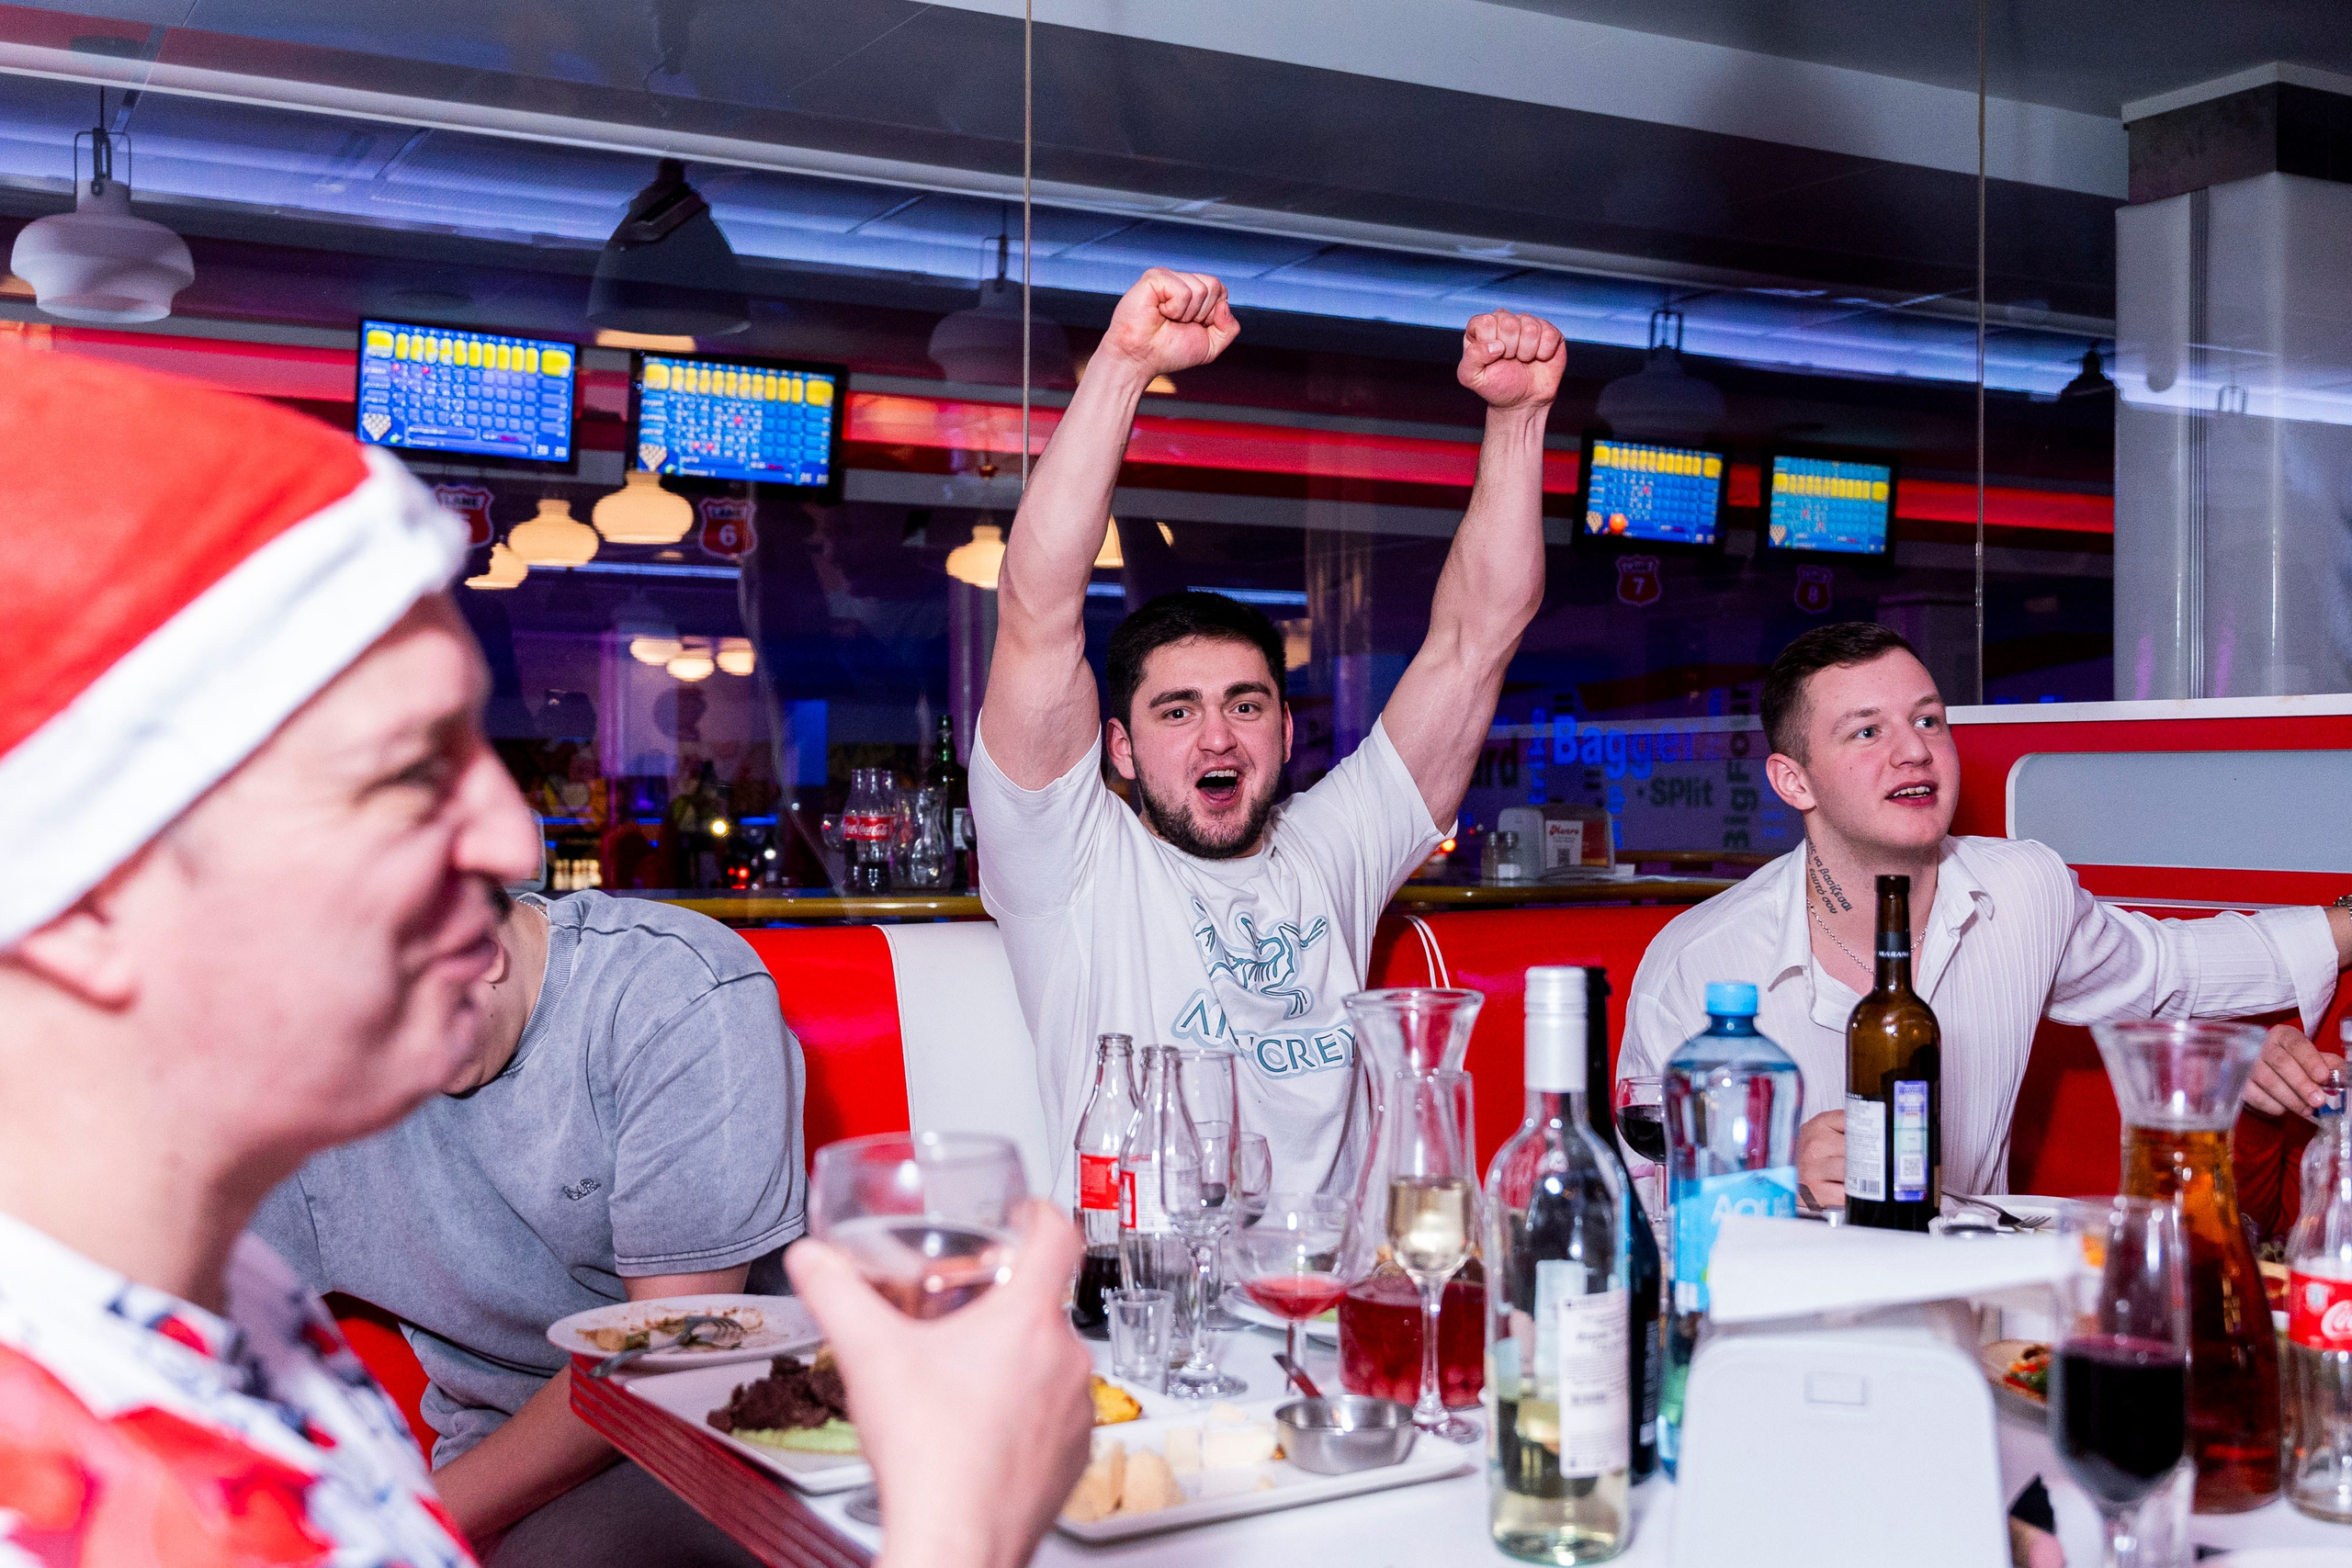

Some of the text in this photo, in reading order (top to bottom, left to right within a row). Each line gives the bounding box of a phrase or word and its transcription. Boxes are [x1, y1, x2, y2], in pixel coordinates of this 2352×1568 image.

[718, 524, 738, 547] 6
[1632, 576, 1645, 596] 7
[1553, 714, 1698, 781] Bagger
[1822, 897, 1838, 914] σου
[1878, 950, 1909, 959] MARANI
